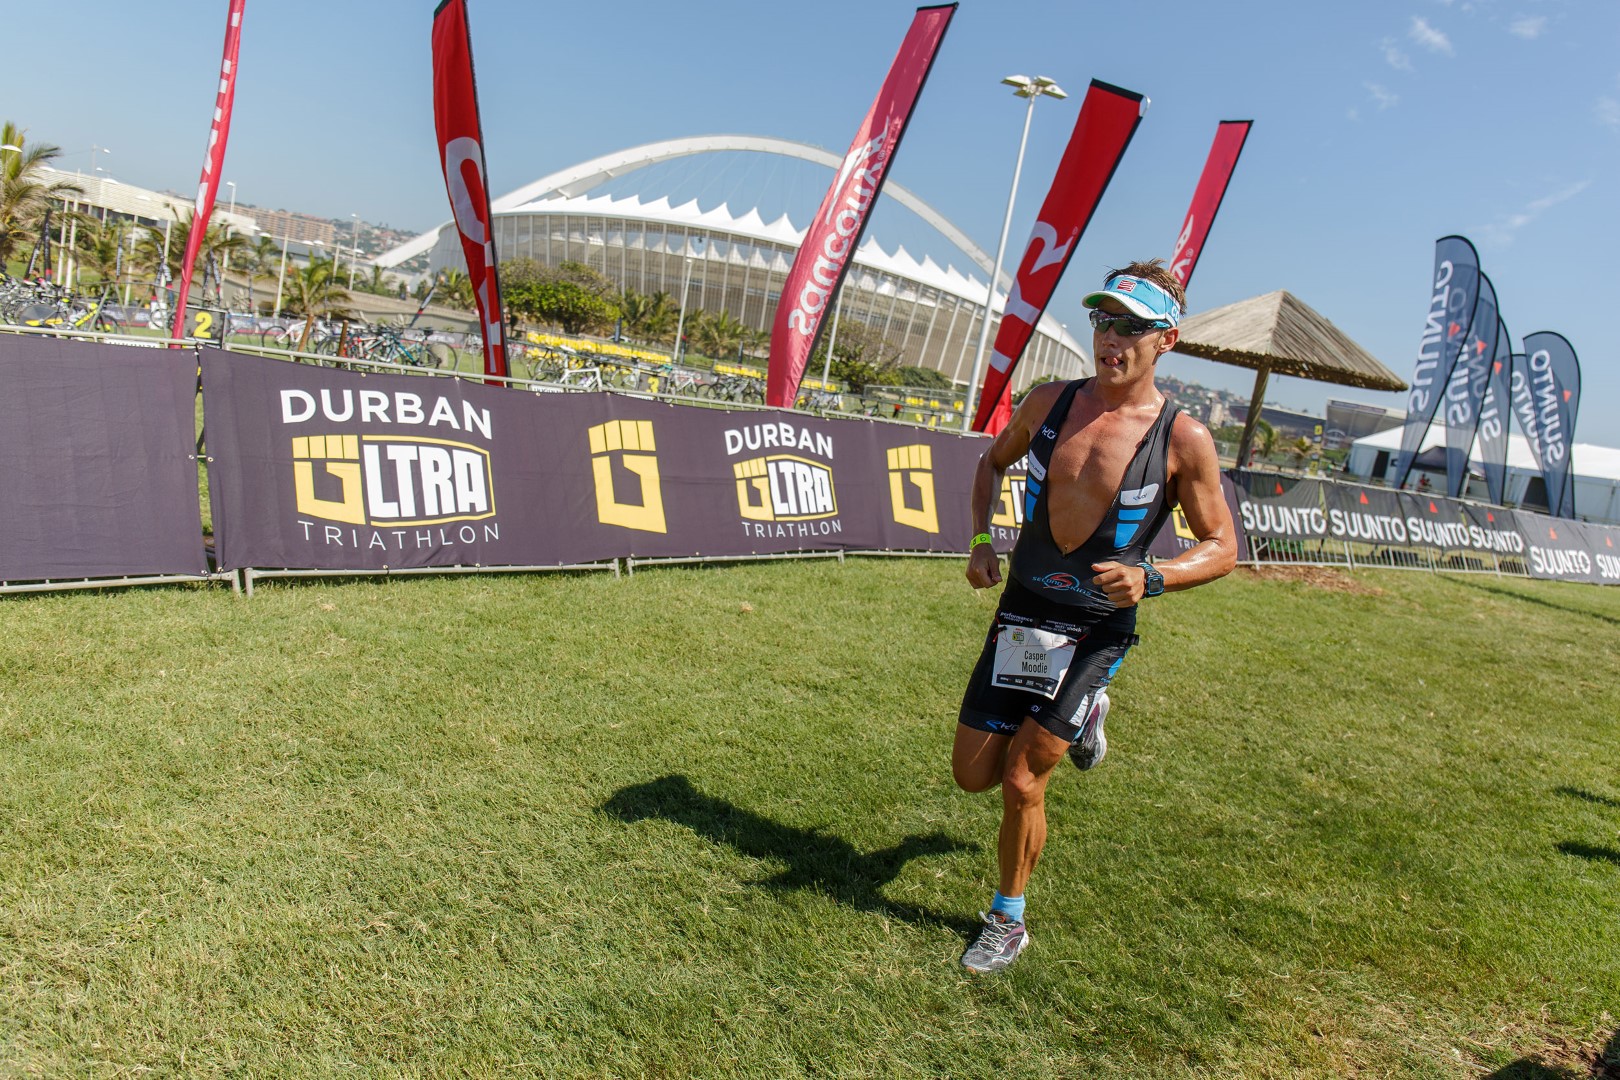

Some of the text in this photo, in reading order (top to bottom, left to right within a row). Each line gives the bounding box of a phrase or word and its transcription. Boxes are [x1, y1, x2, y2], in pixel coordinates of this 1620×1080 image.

[194, 312, 214, 338] 2
[280, 388, 492, 440] DURBAN
[724, 422, 833, 459] DURBAN
[742, 518, 842, 539] TRIATHLON
[1241, 500, 1327, 535] SUUNTO
[1331, 508, 1407, 543] SUUNTO
[1410, 517, 1470, 548] SUUNTO
[297, 520, 501, 551] TRIATHLON
[1470, 525, 1524, 554] SUUNTO
[1530, 545, 1591, 574] SUUNTO
[1021, 661, 1048, 674] Moodie
[1024, 650, 1047, 662] Casper
